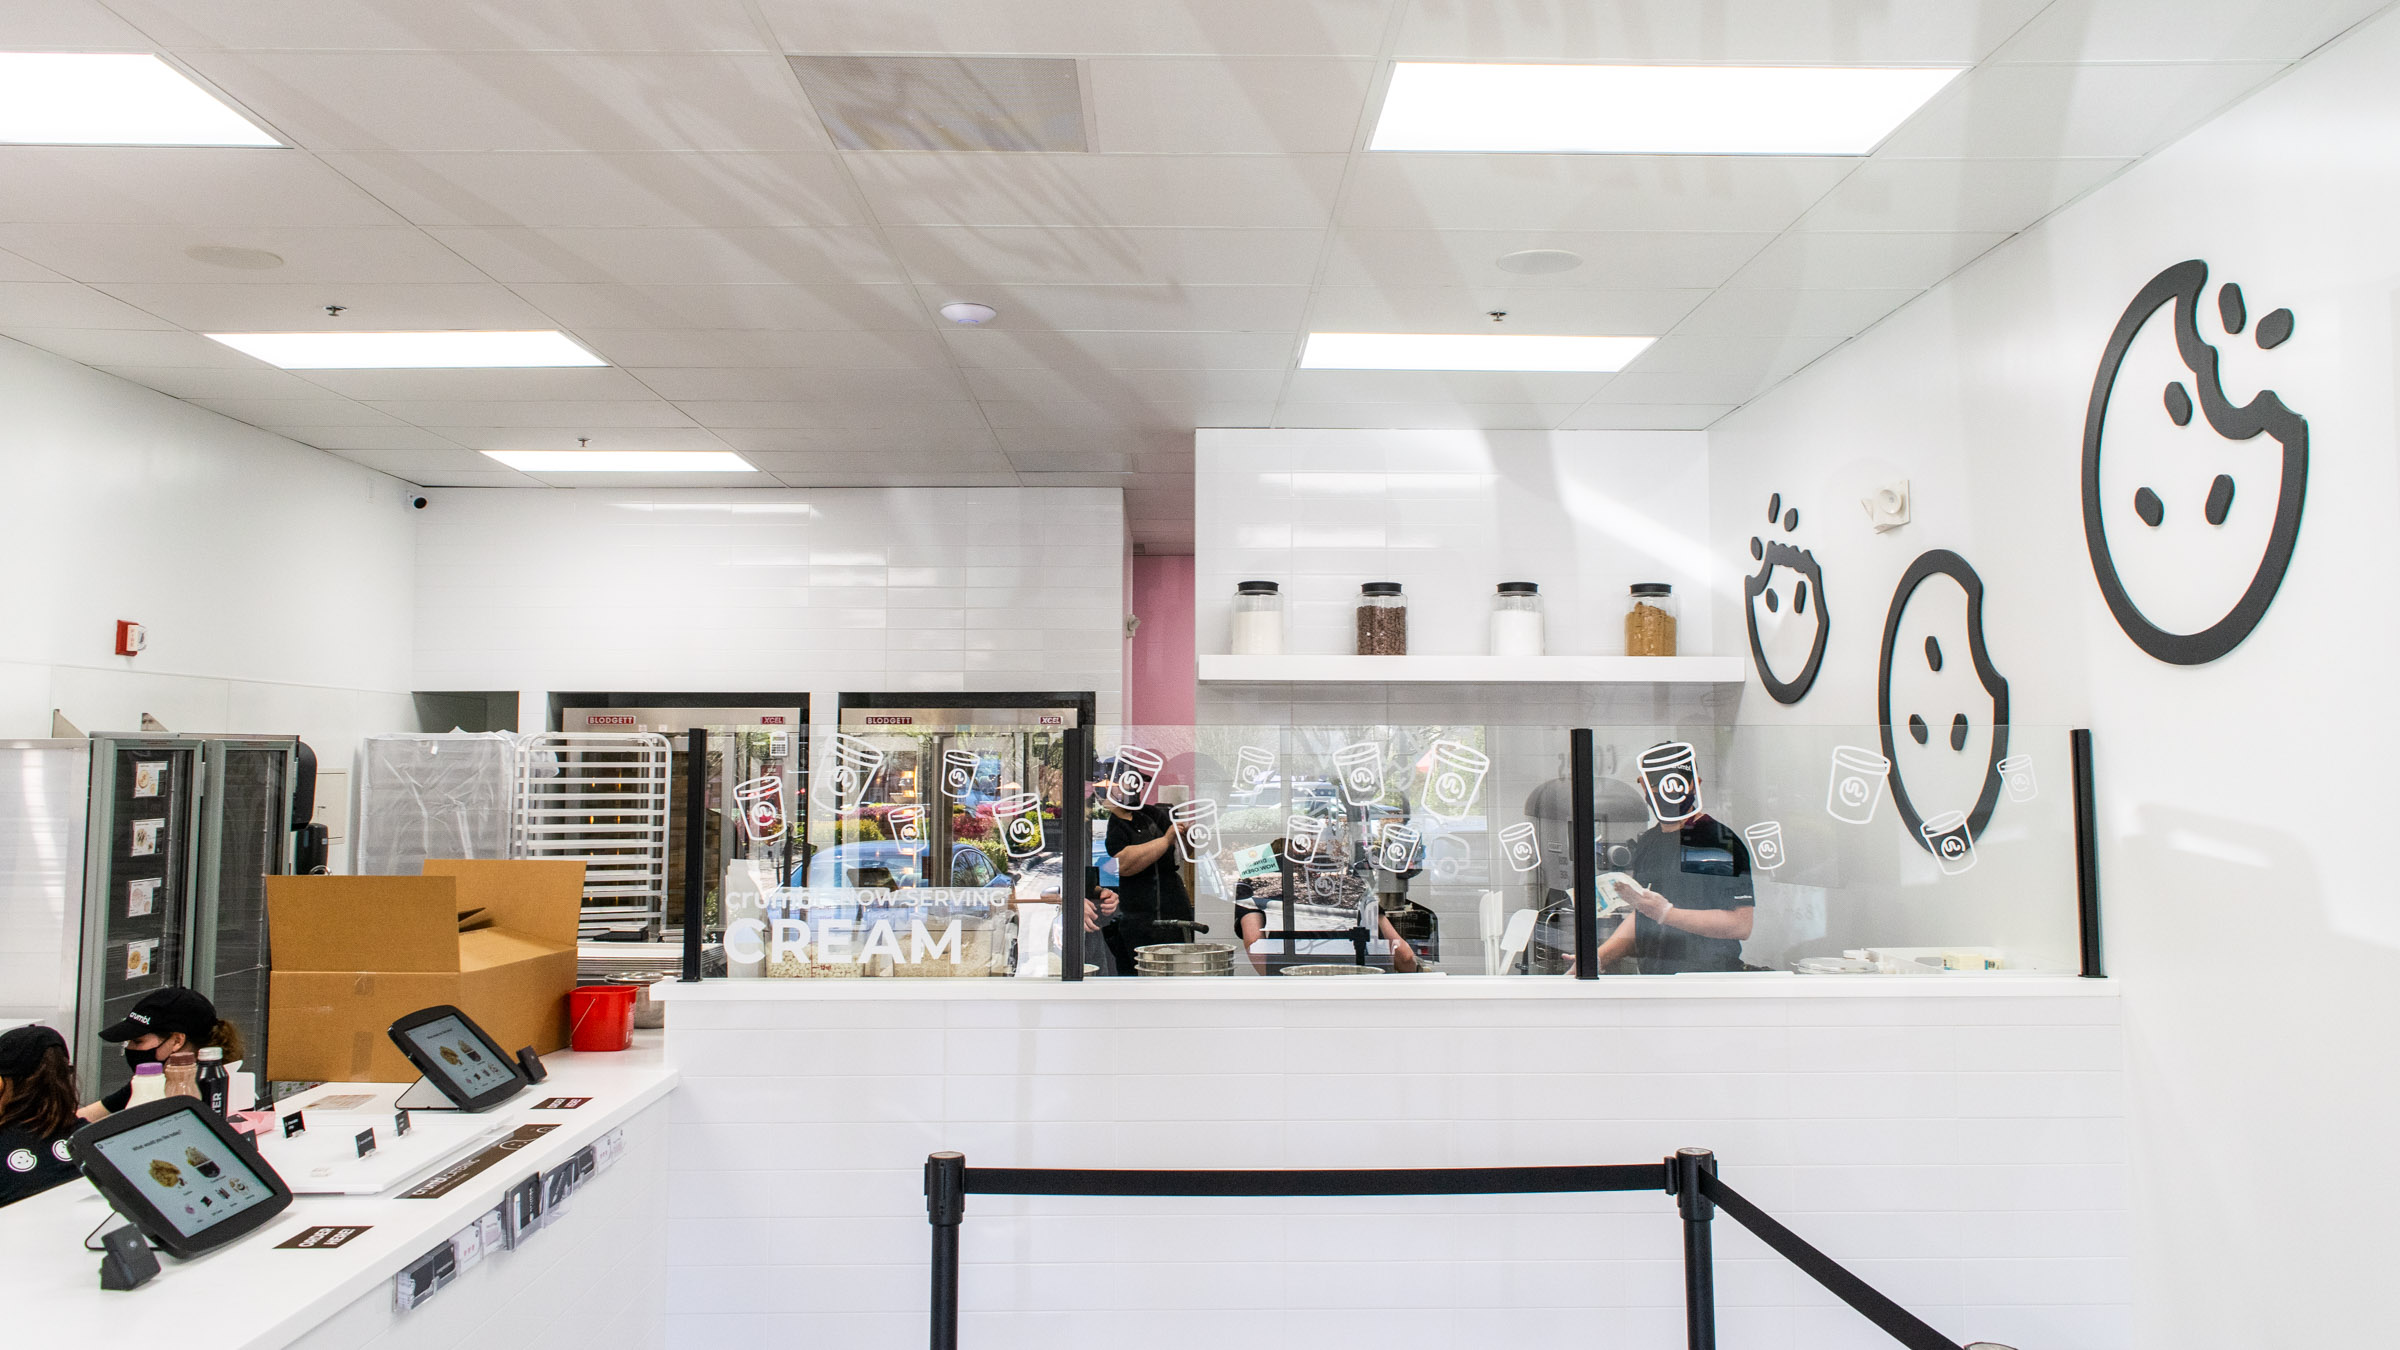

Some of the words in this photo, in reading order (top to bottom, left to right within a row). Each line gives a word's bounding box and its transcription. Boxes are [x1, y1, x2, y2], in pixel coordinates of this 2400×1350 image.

[589, 716, 633, 724] BLODGETT
[763, 716, 783, 724] XCEL
[725, 888, 822, 910] crumb
[840, 889, 896, 906] NOW
[904, 889, 1006, 907] SERVING
[723, 918, 962, 965] CREAM
[297, 1227, 336, 1248] ORDER
